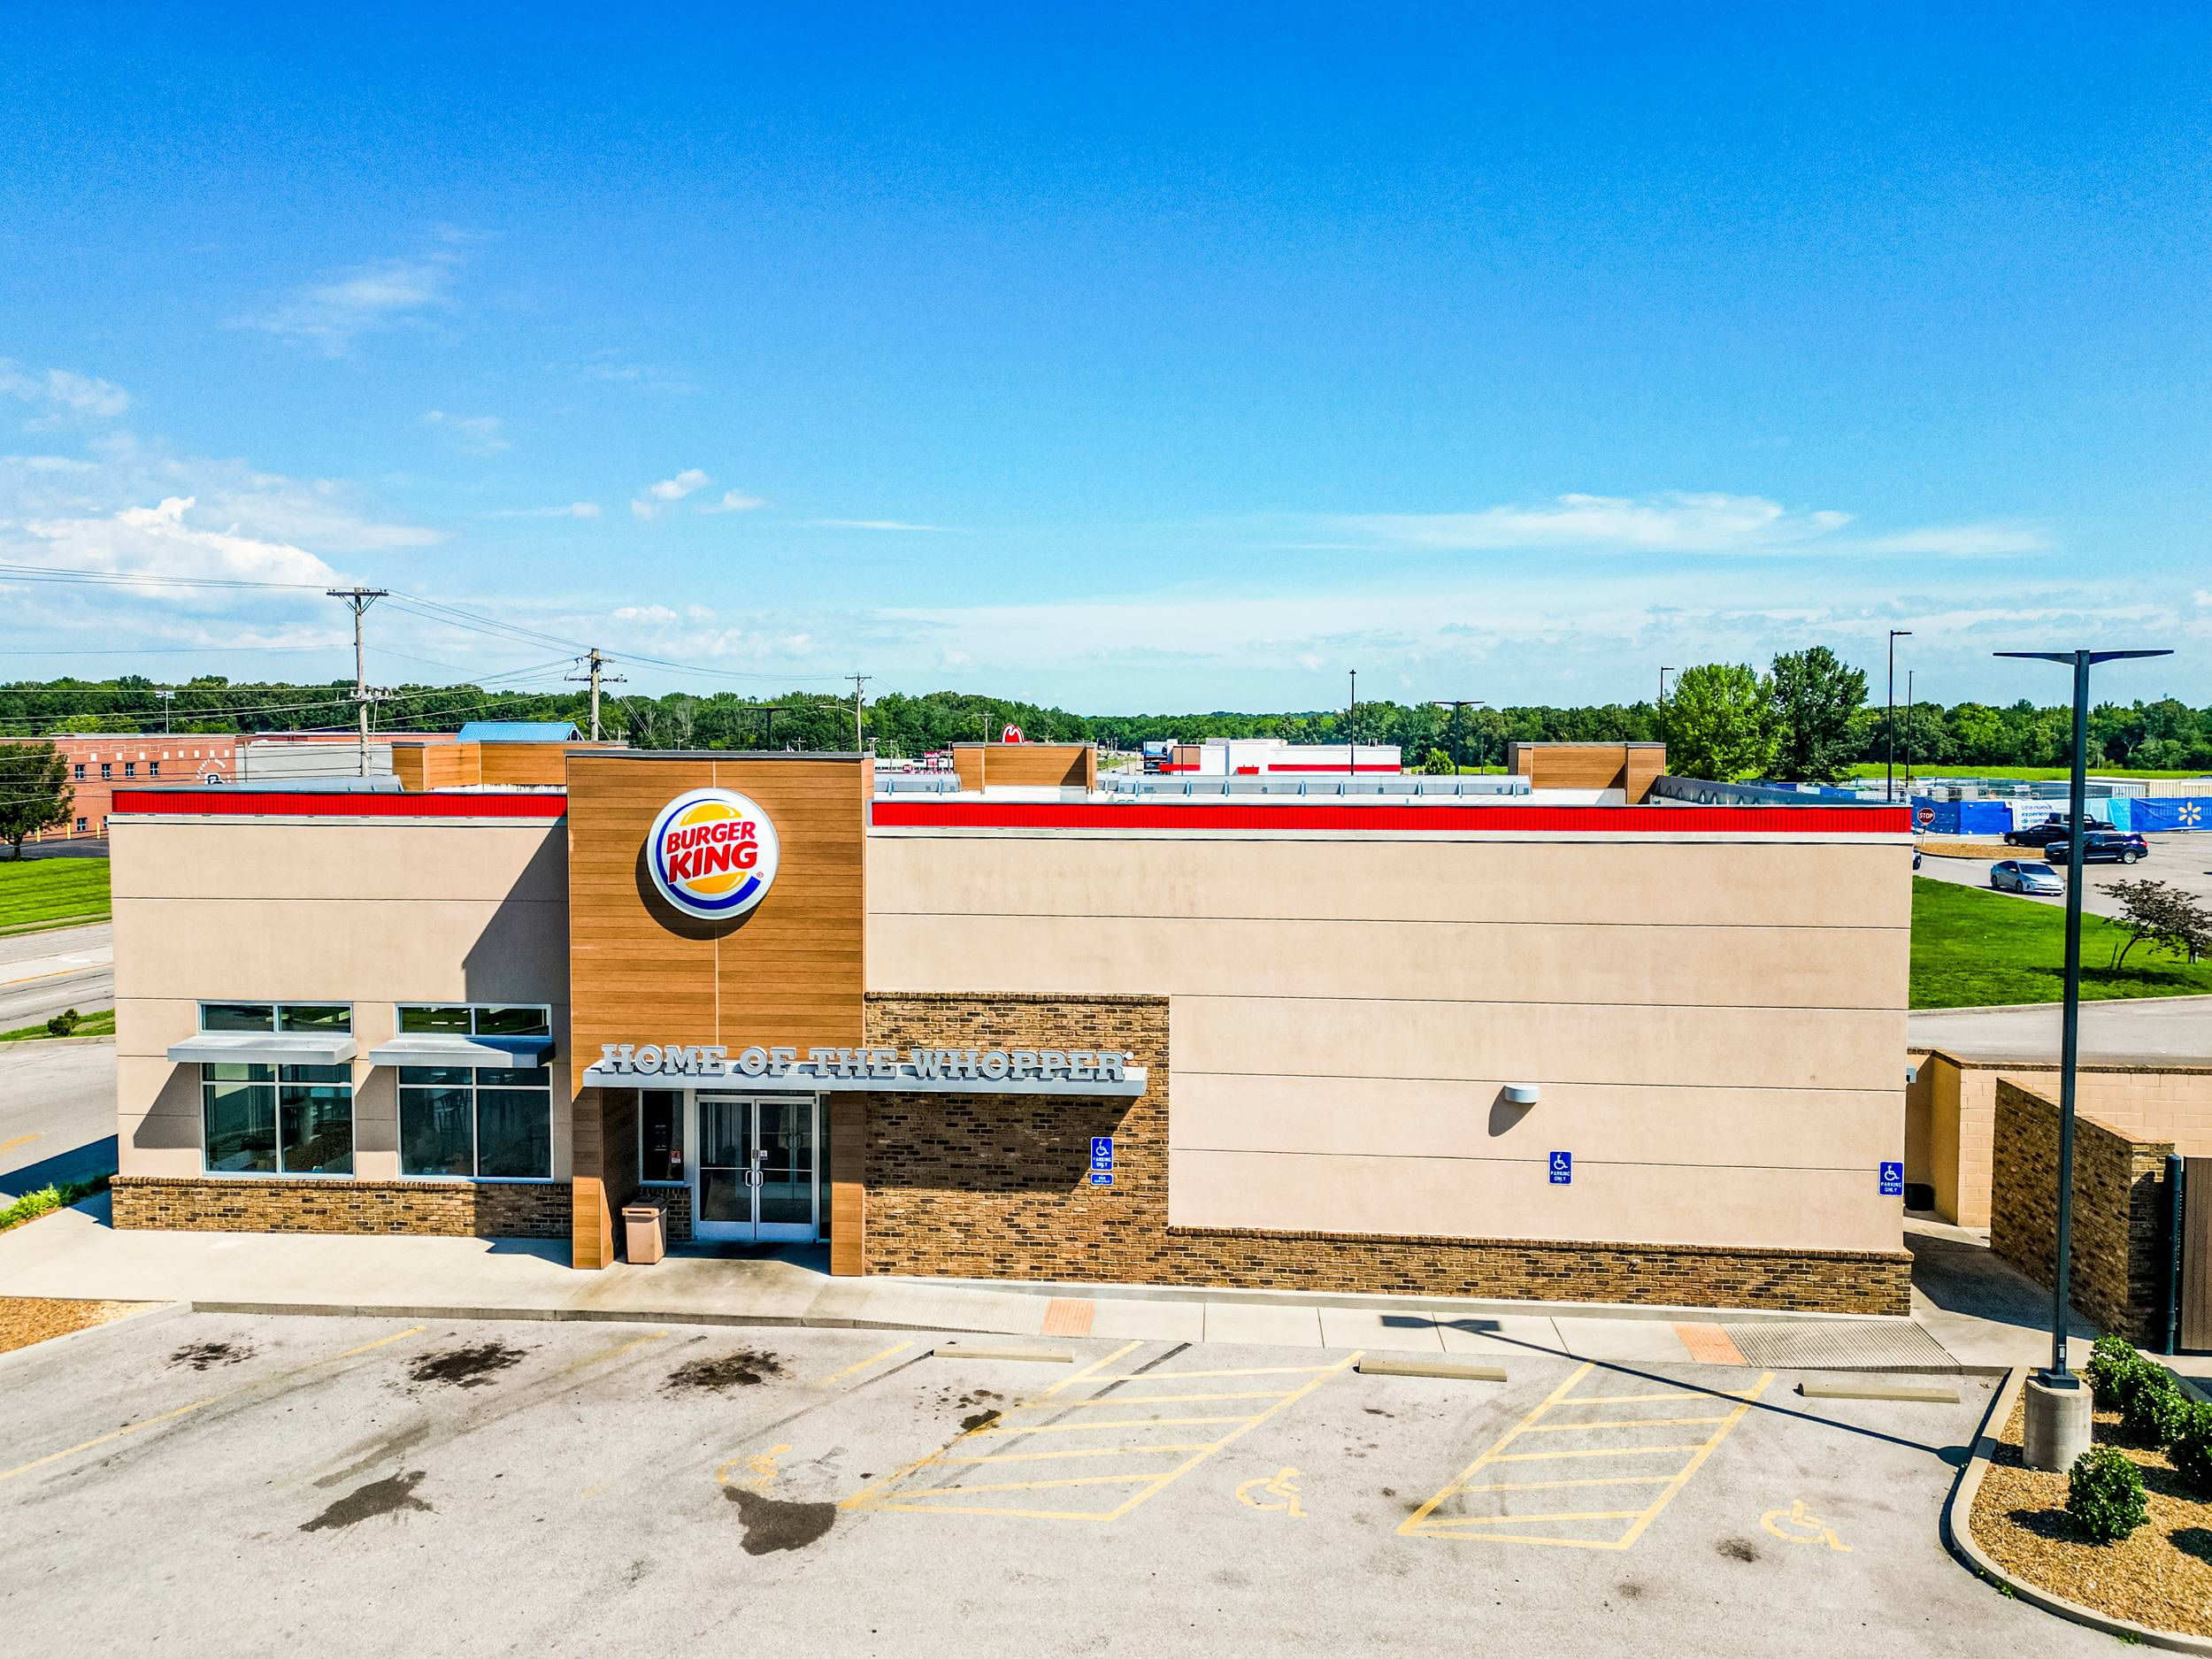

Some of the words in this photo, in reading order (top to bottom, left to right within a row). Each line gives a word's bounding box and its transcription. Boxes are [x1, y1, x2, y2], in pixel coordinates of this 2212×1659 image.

[666, 821, 756, 854] BURGER
[669, 841, 758, 883] KING
[601, 1044, 727, 1076] HOME
[739, 1046, 796, 1077] OF
[809, 1048, 897, 1078] THE
[911, 1048, 1125, 1081] WHOPPER
